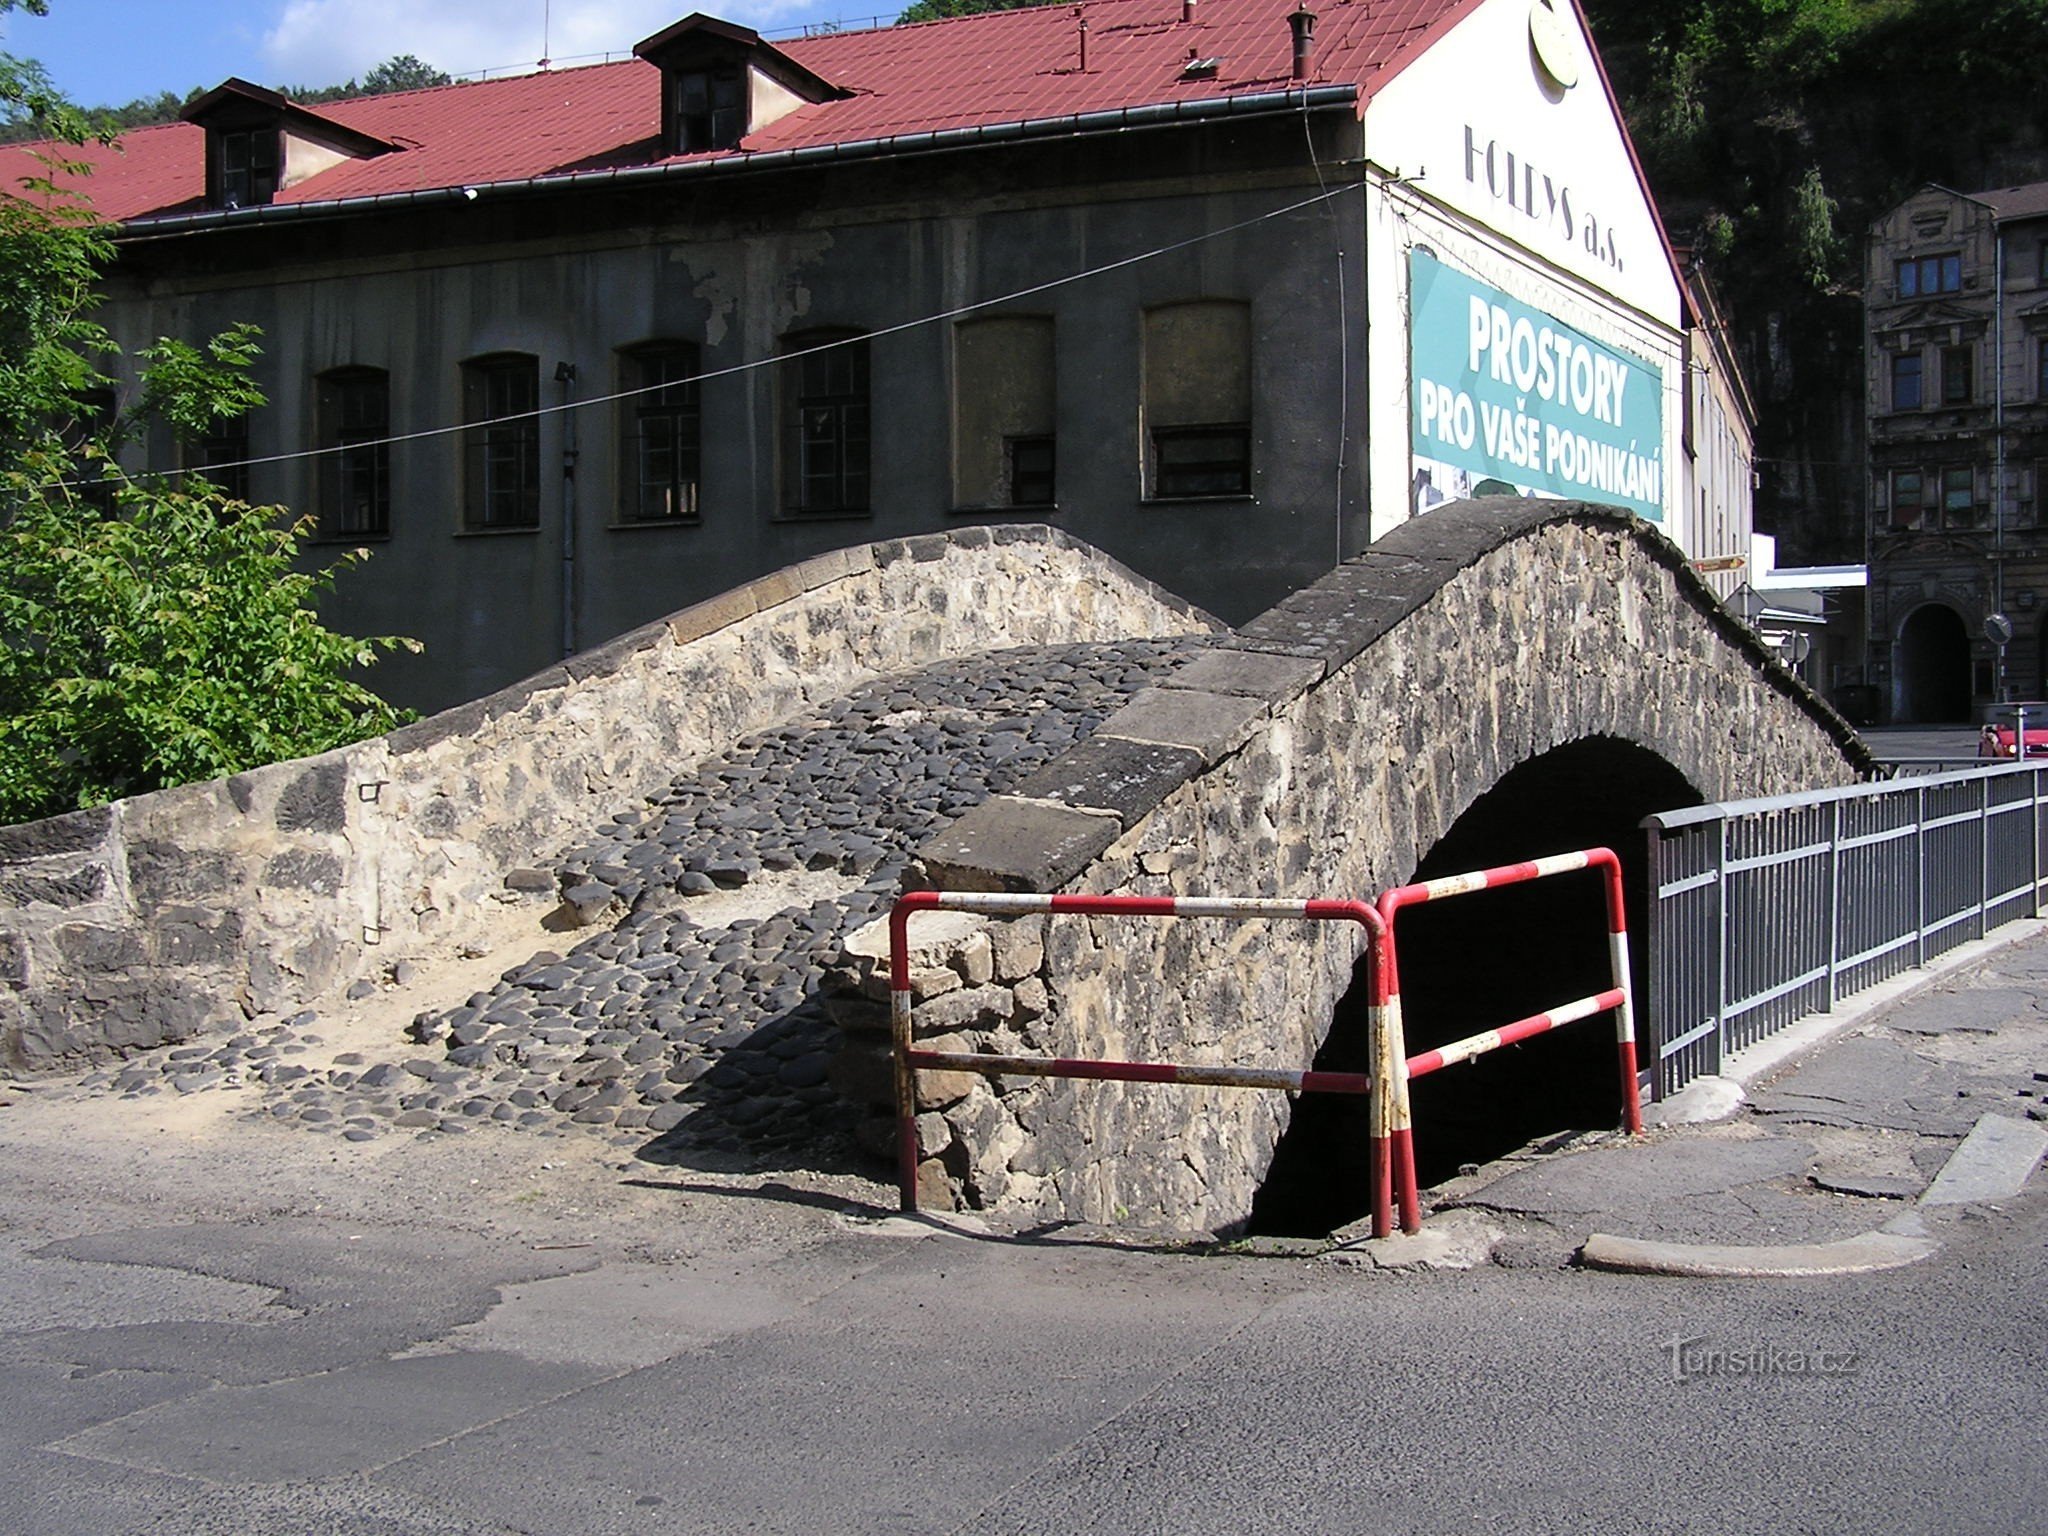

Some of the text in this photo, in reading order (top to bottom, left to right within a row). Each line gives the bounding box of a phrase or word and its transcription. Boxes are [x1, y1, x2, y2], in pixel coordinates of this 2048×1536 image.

[1464, 124, 1623, 273] HOLDYS a.s.
[1469, 294, 1629, 427] PROSTORY
[1420, 377, 1660, 505] PRO VAŠE PODNIKÁNÍ
